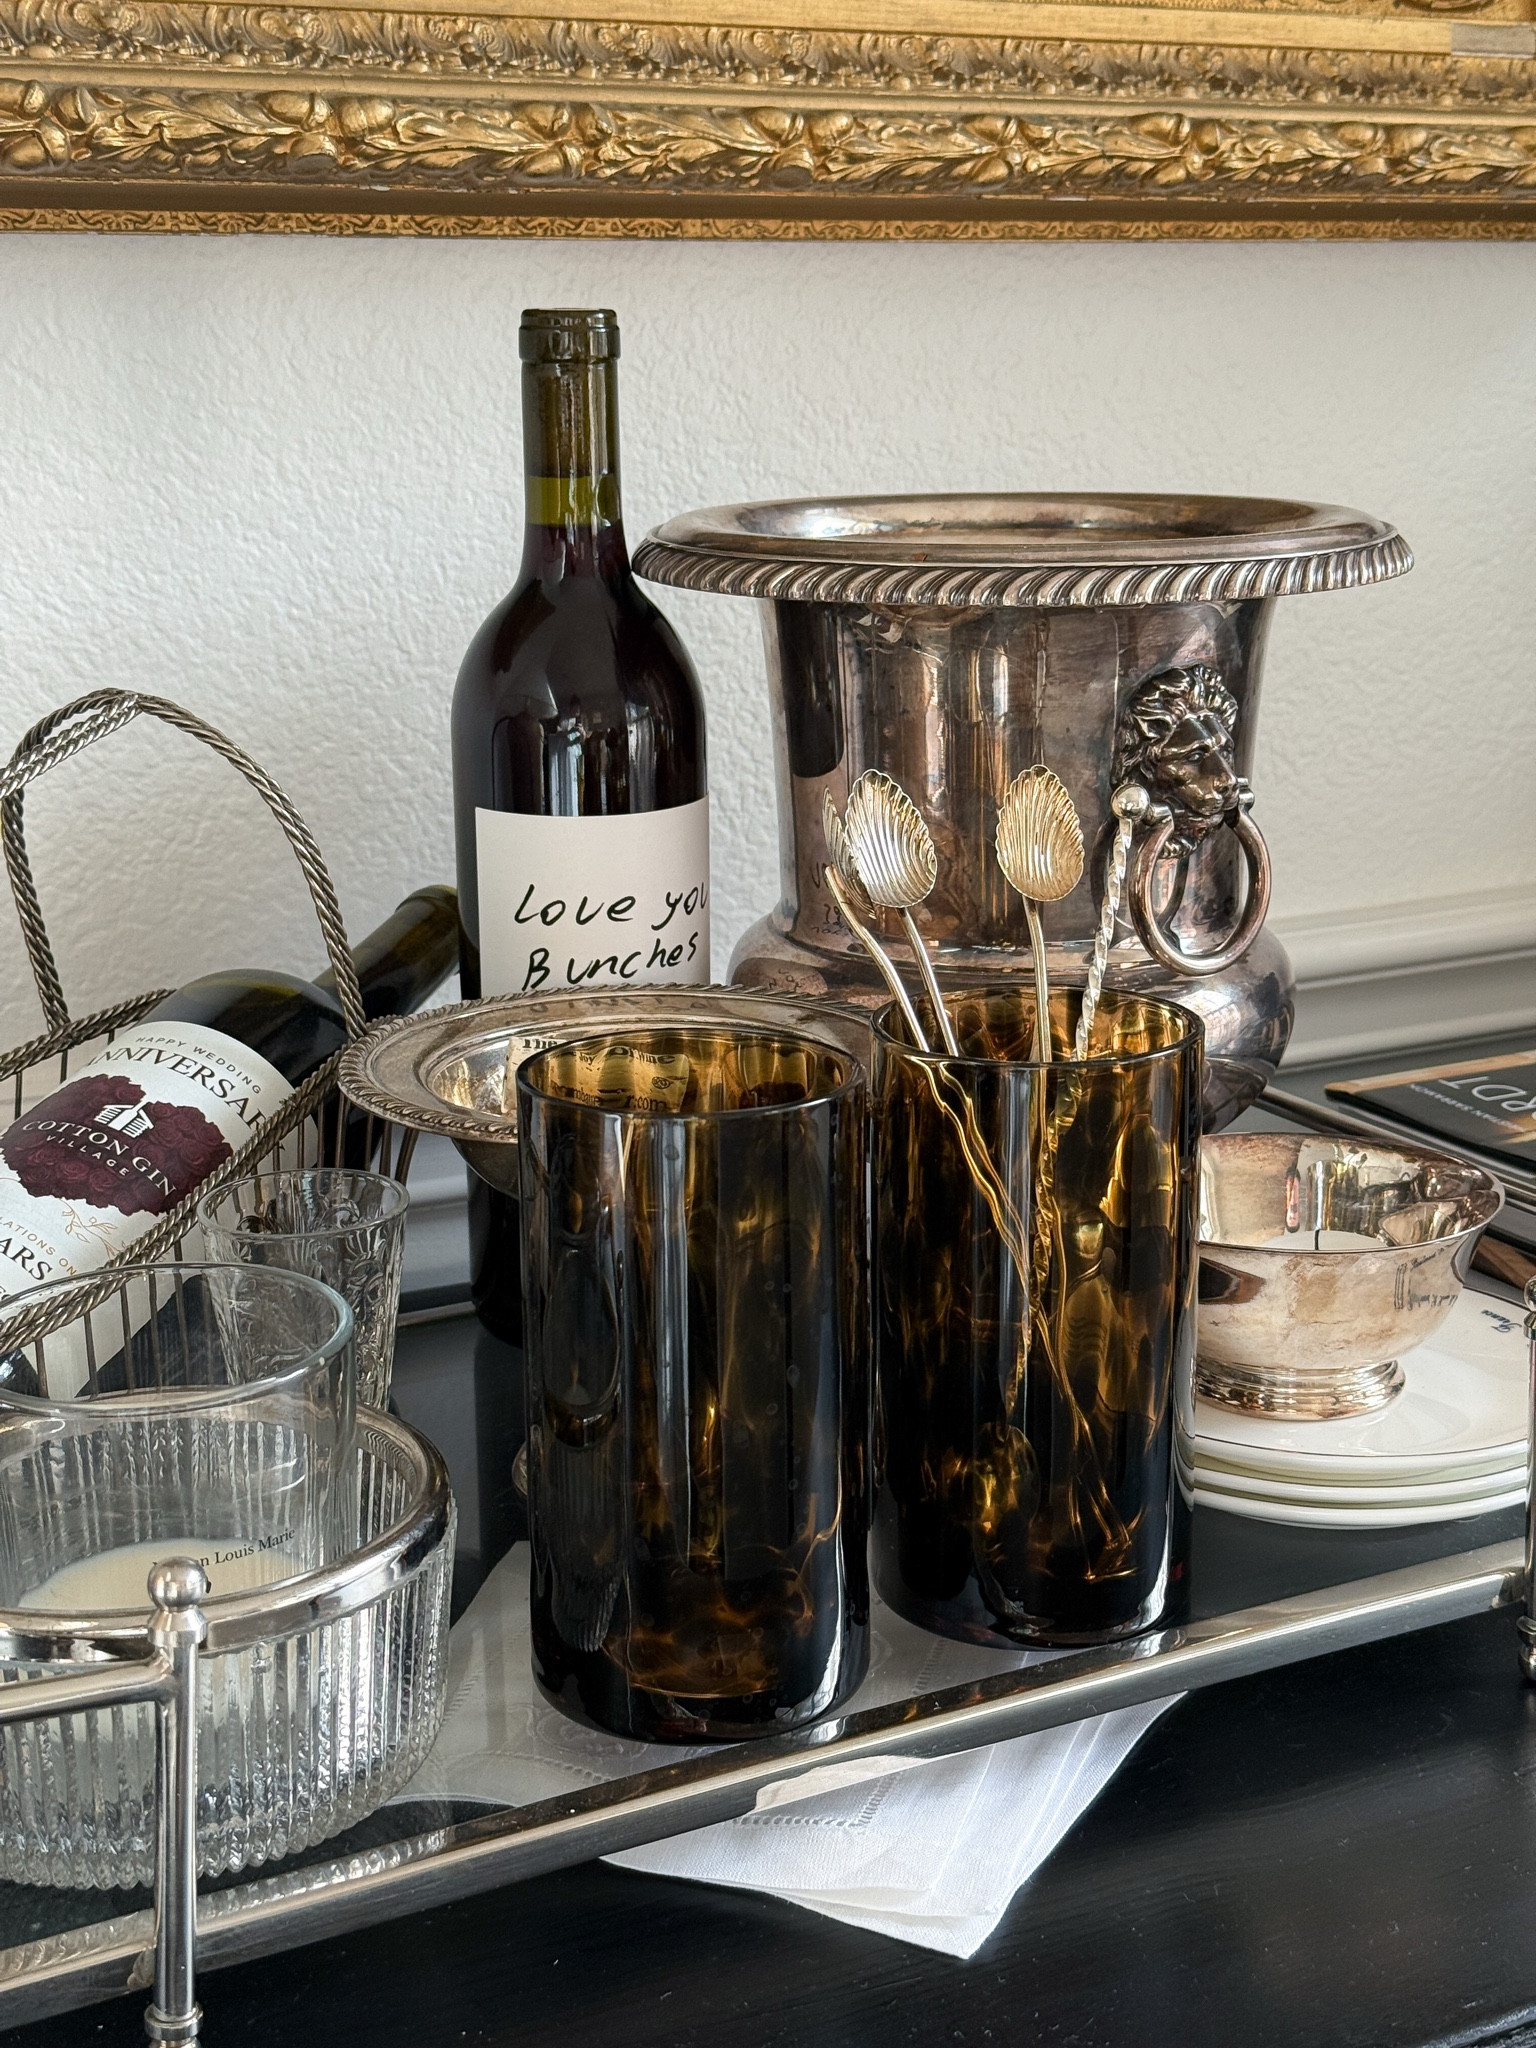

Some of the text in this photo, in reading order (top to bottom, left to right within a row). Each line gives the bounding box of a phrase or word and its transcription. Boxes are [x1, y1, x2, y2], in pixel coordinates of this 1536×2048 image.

[651, 882, 708, 931] you
[521, 931, 699, 991] Bunches
[136, 1037, 262, 1094] HAPPY WEDDING
[1439, 1076, 1536, 1119] RDT
[22, 1120, 177, 1197] COTTON GIN
[46, 1134, 130, 1176] VILLAGE
[0, 1216, 77, 1276] ATIONS ON
[214, 1544, 255, 1564] Louis
[258, 1528, 296, 1551] Marie
